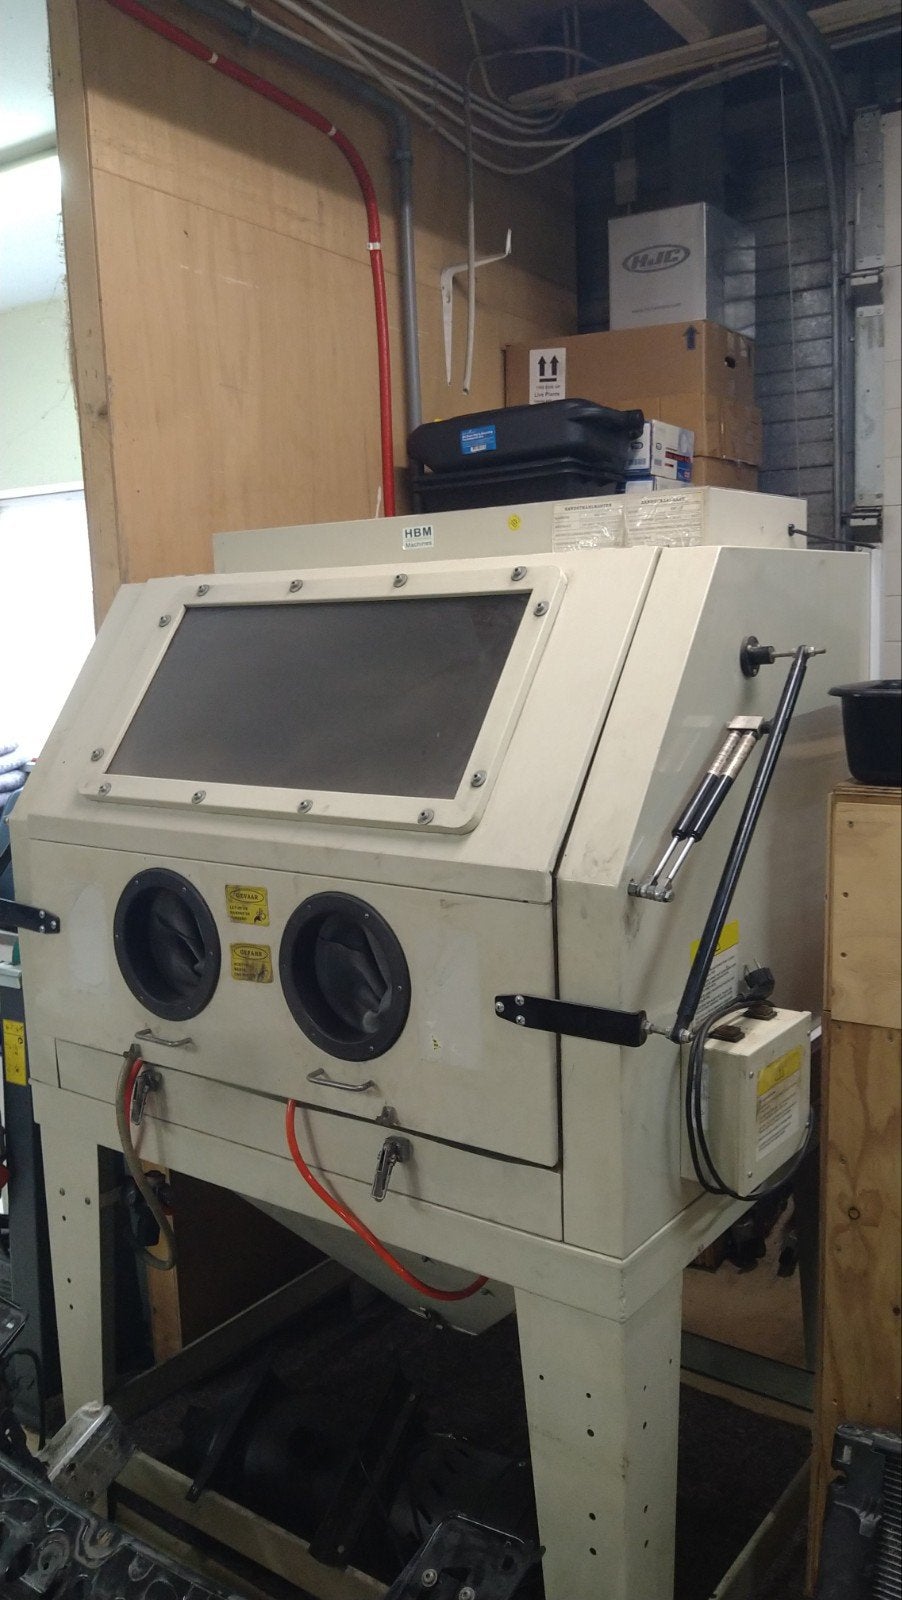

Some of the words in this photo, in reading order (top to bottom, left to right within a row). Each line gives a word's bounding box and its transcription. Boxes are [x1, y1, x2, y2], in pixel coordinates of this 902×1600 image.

[631, 248, 680, 269] HJC
[405, 526, 432, 538] HBM
[405, 541, 432, 549] Machines
[235, 892, 259, 901] GEVAAR
